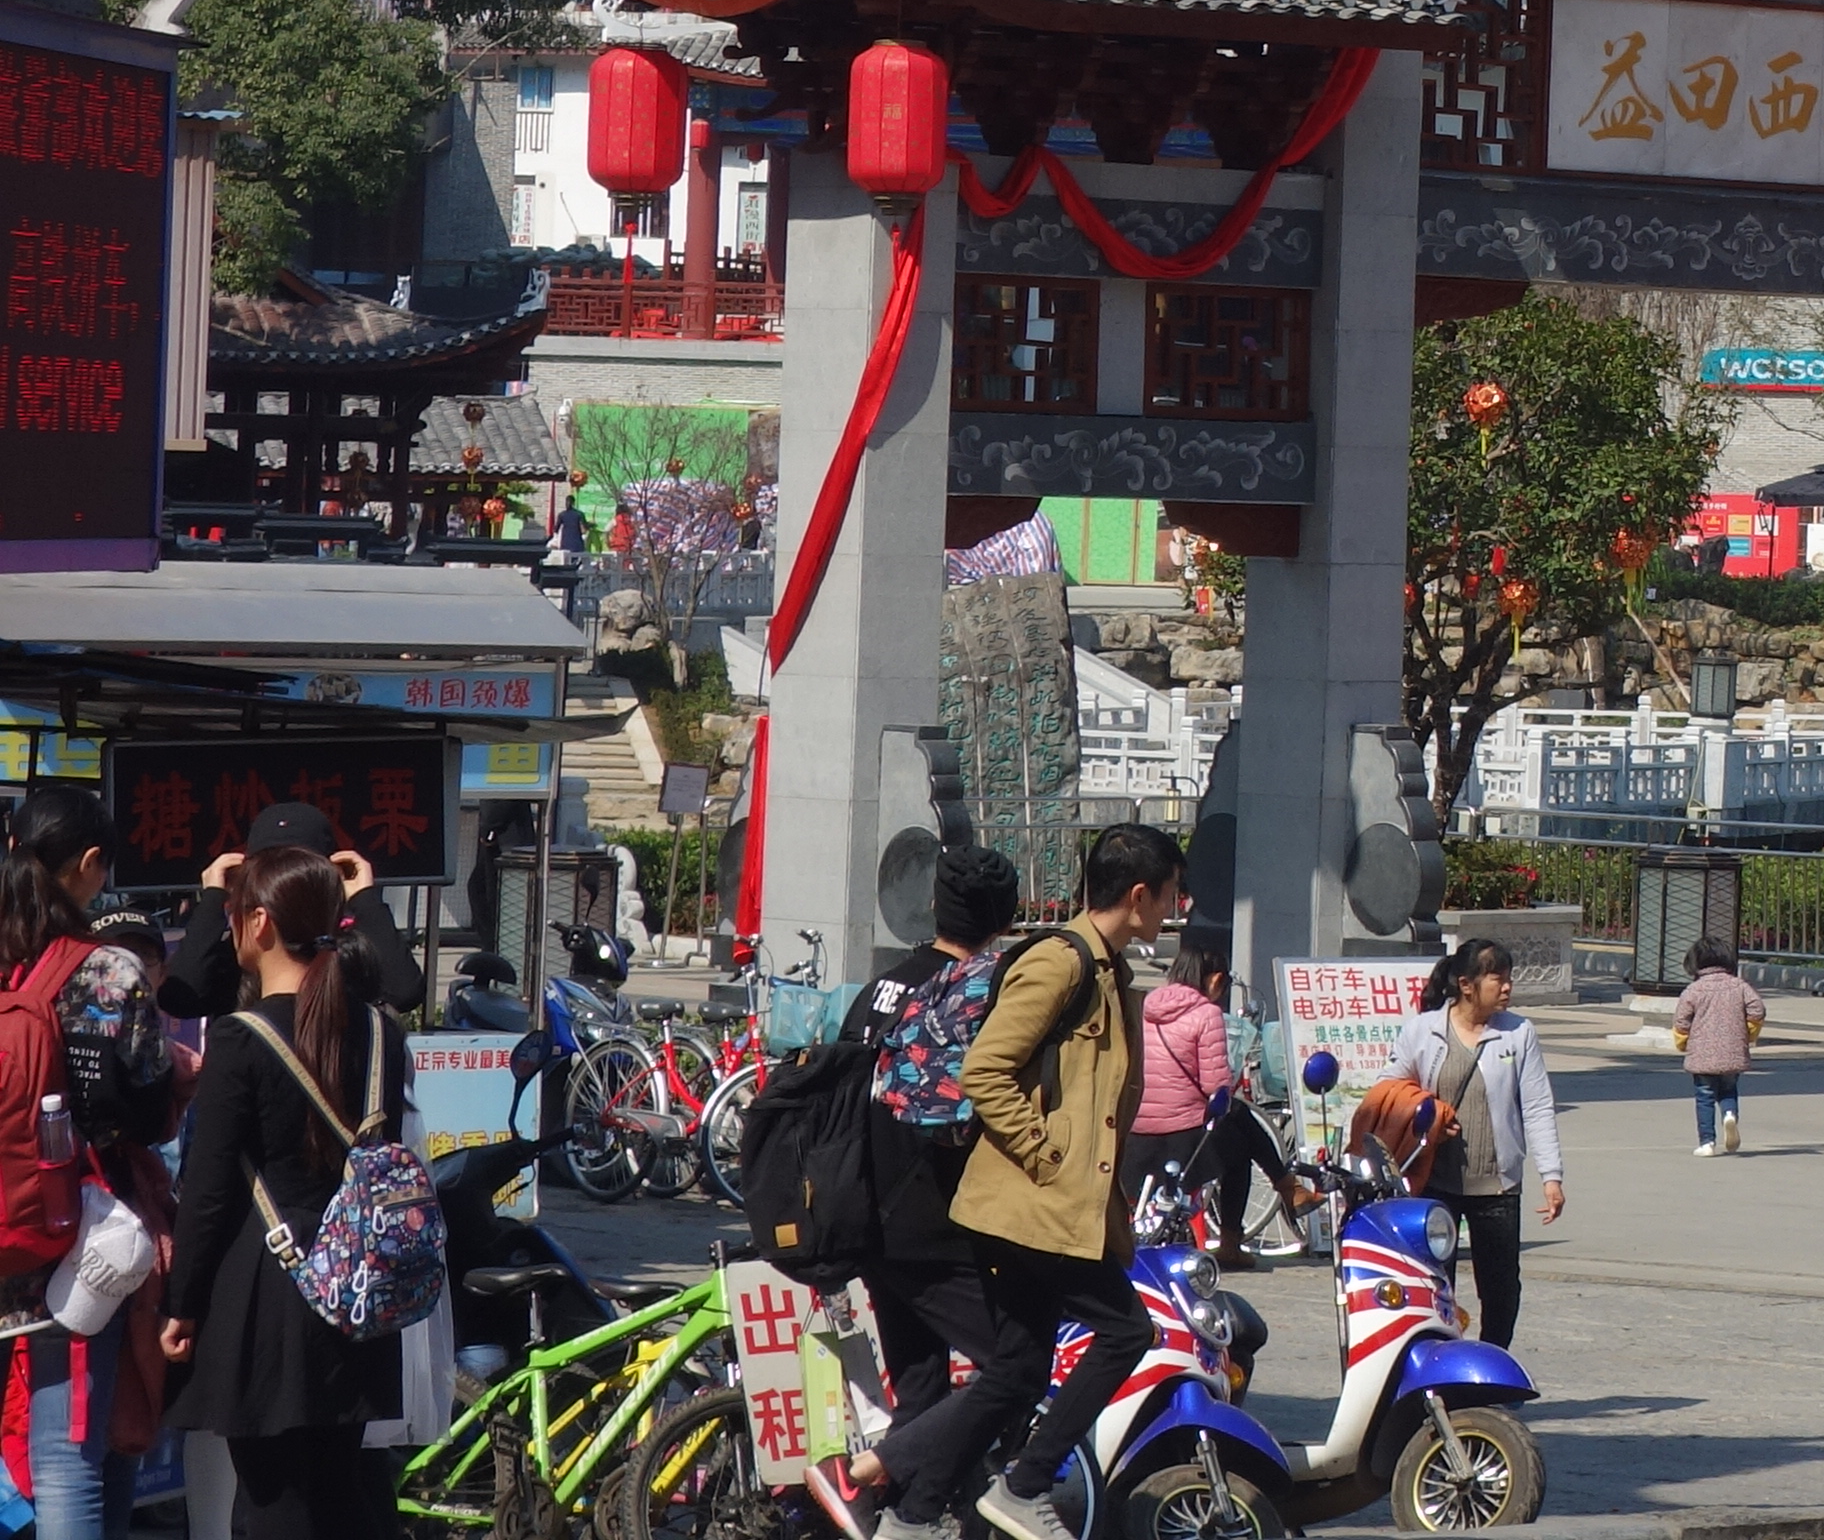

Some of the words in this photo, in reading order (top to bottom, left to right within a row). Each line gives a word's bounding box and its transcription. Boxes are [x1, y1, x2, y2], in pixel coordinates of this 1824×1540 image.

[1289, 967, 1366, 992] 自行车
[1292, 996, 1371, 1020] 电动车
[1315, 1025, 1402, 1043] 提供各景点优
[1356, 1044, 1394, 1058] 导游服
[740, 1284, 807, 1462] 出租
